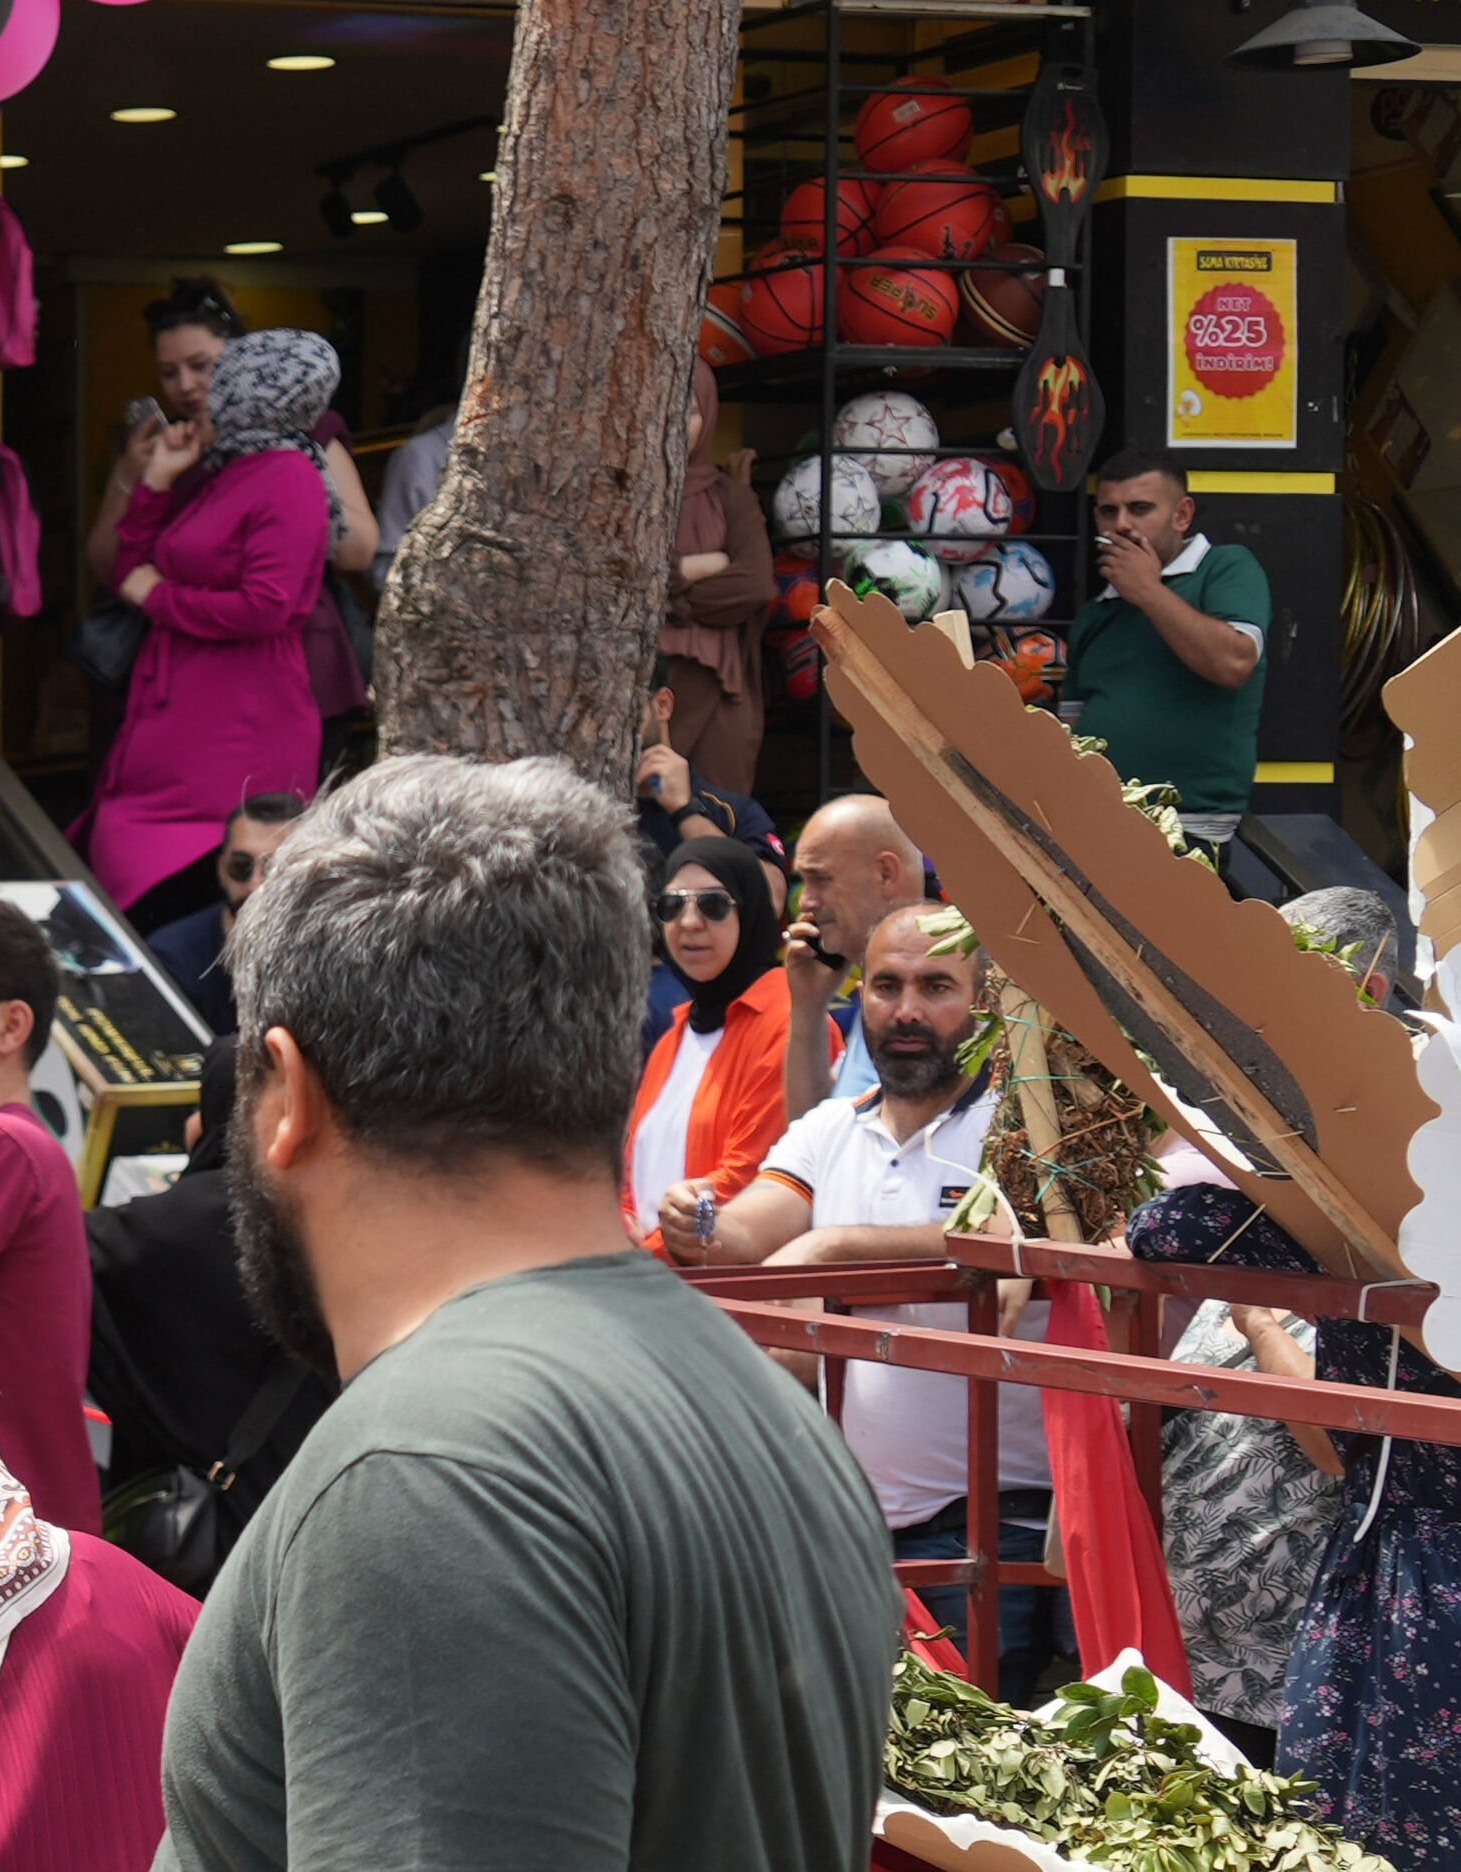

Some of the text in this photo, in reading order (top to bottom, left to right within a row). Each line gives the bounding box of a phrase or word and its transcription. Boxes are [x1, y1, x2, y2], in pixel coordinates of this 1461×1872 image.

[1218, 297, 1252, 311] NET
[1190, 315, 1267, 347] %25
[1196, 352, 1275, 371] İNDİRİM!
